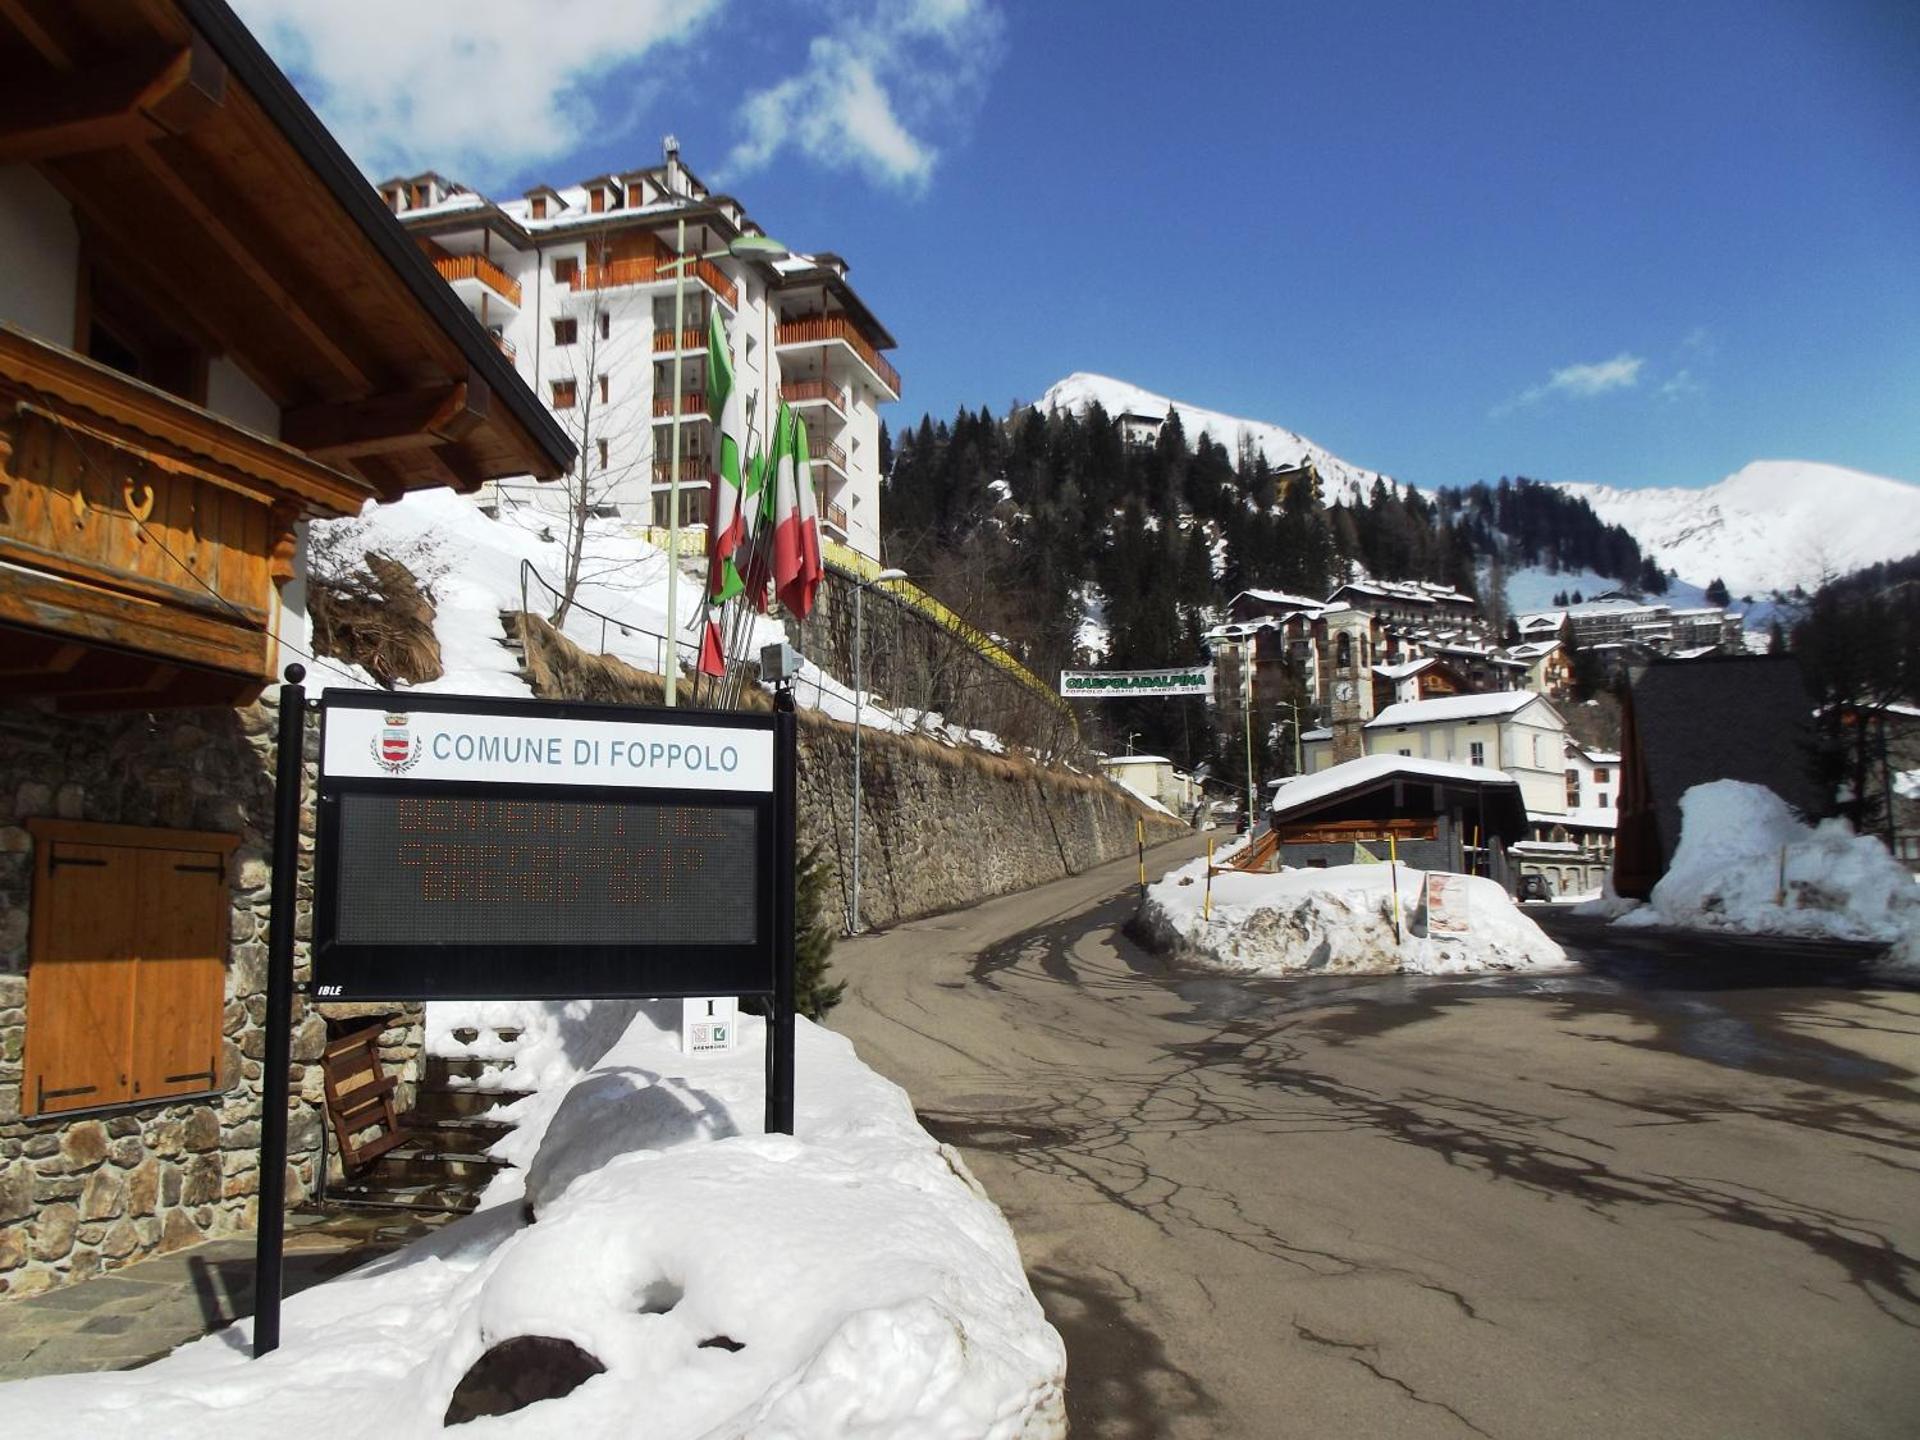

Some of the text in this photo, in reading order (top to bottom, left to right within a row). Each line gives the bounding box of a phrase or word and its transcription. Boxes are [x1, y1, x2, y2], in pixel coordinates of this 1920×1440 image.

[433, 732, 739, 773] COMUNE DI FOPPOLO
[399, 799, 727, 839] BENVENUTI NEL
[424, 870, 580, 902] BREMBO
[317, 985, 343, 996] IBLE
